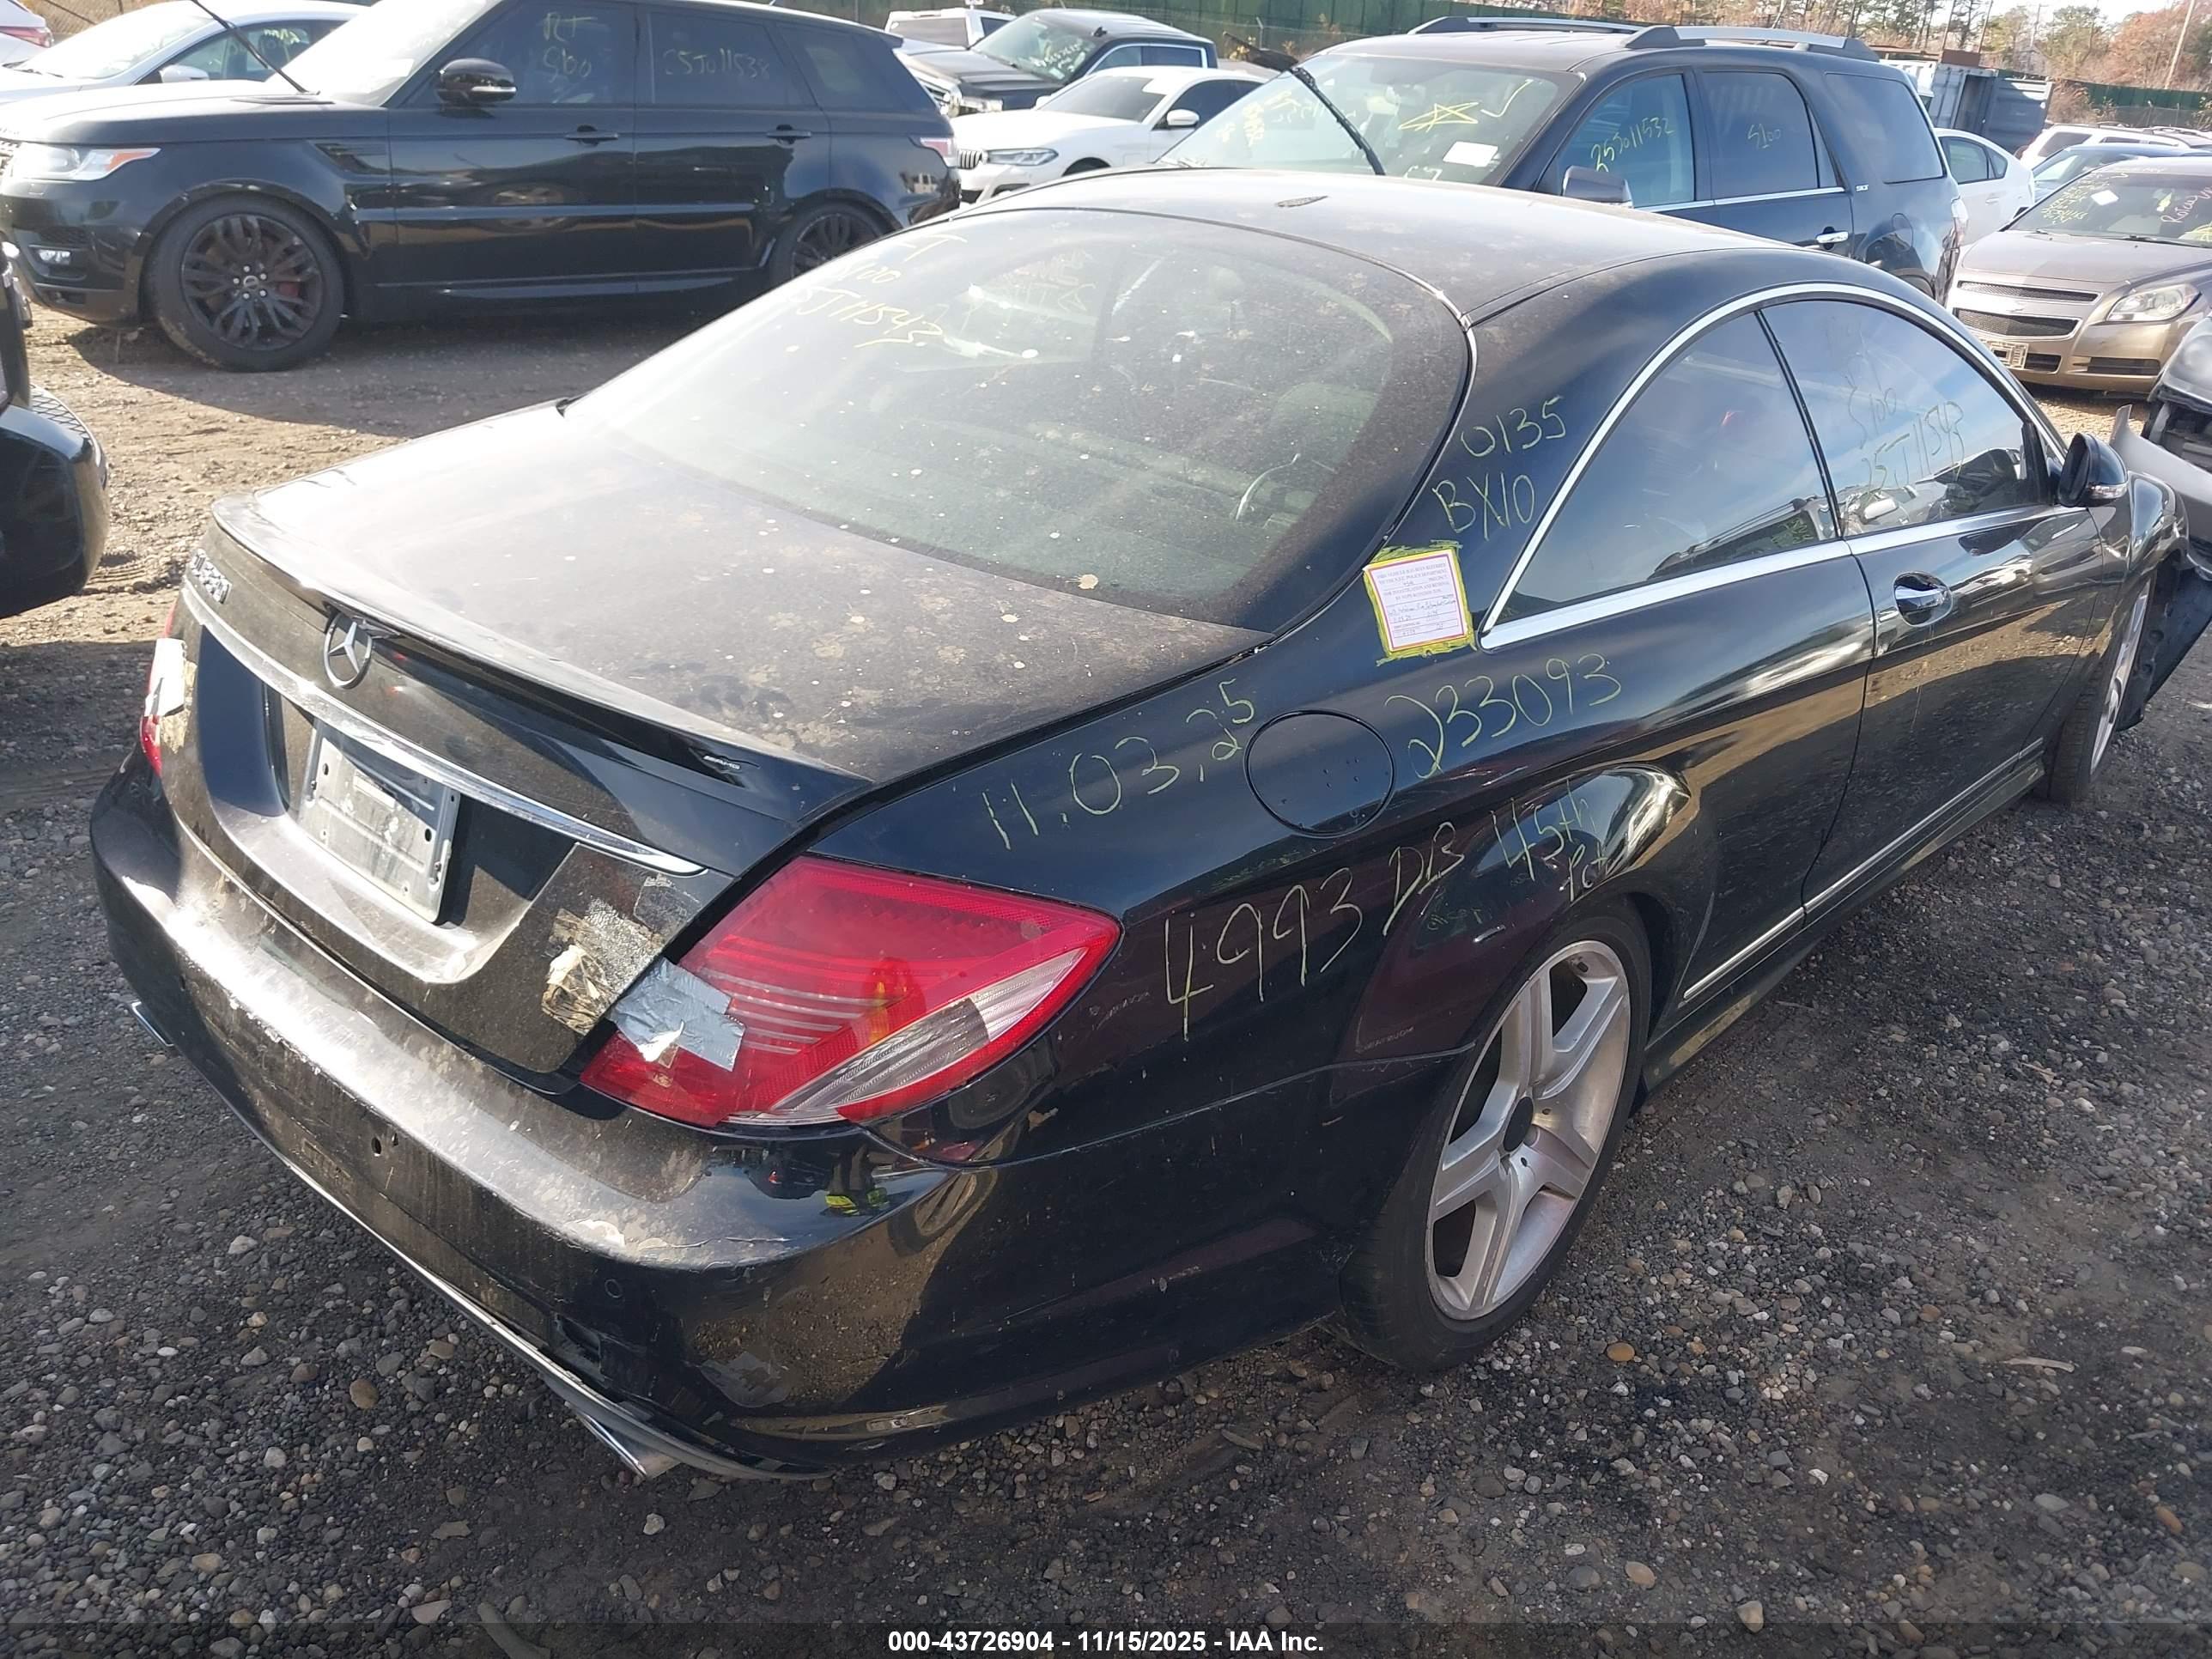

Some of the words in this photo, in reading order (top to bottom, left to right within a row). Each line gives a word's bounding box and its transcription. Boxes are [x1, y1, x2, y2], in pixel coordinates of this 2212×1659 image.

[1460, 395, 1568, 458] 0135
[1383, 653, 1622, 780] 233093
[1164, 866, 1364, 1042] 4993
